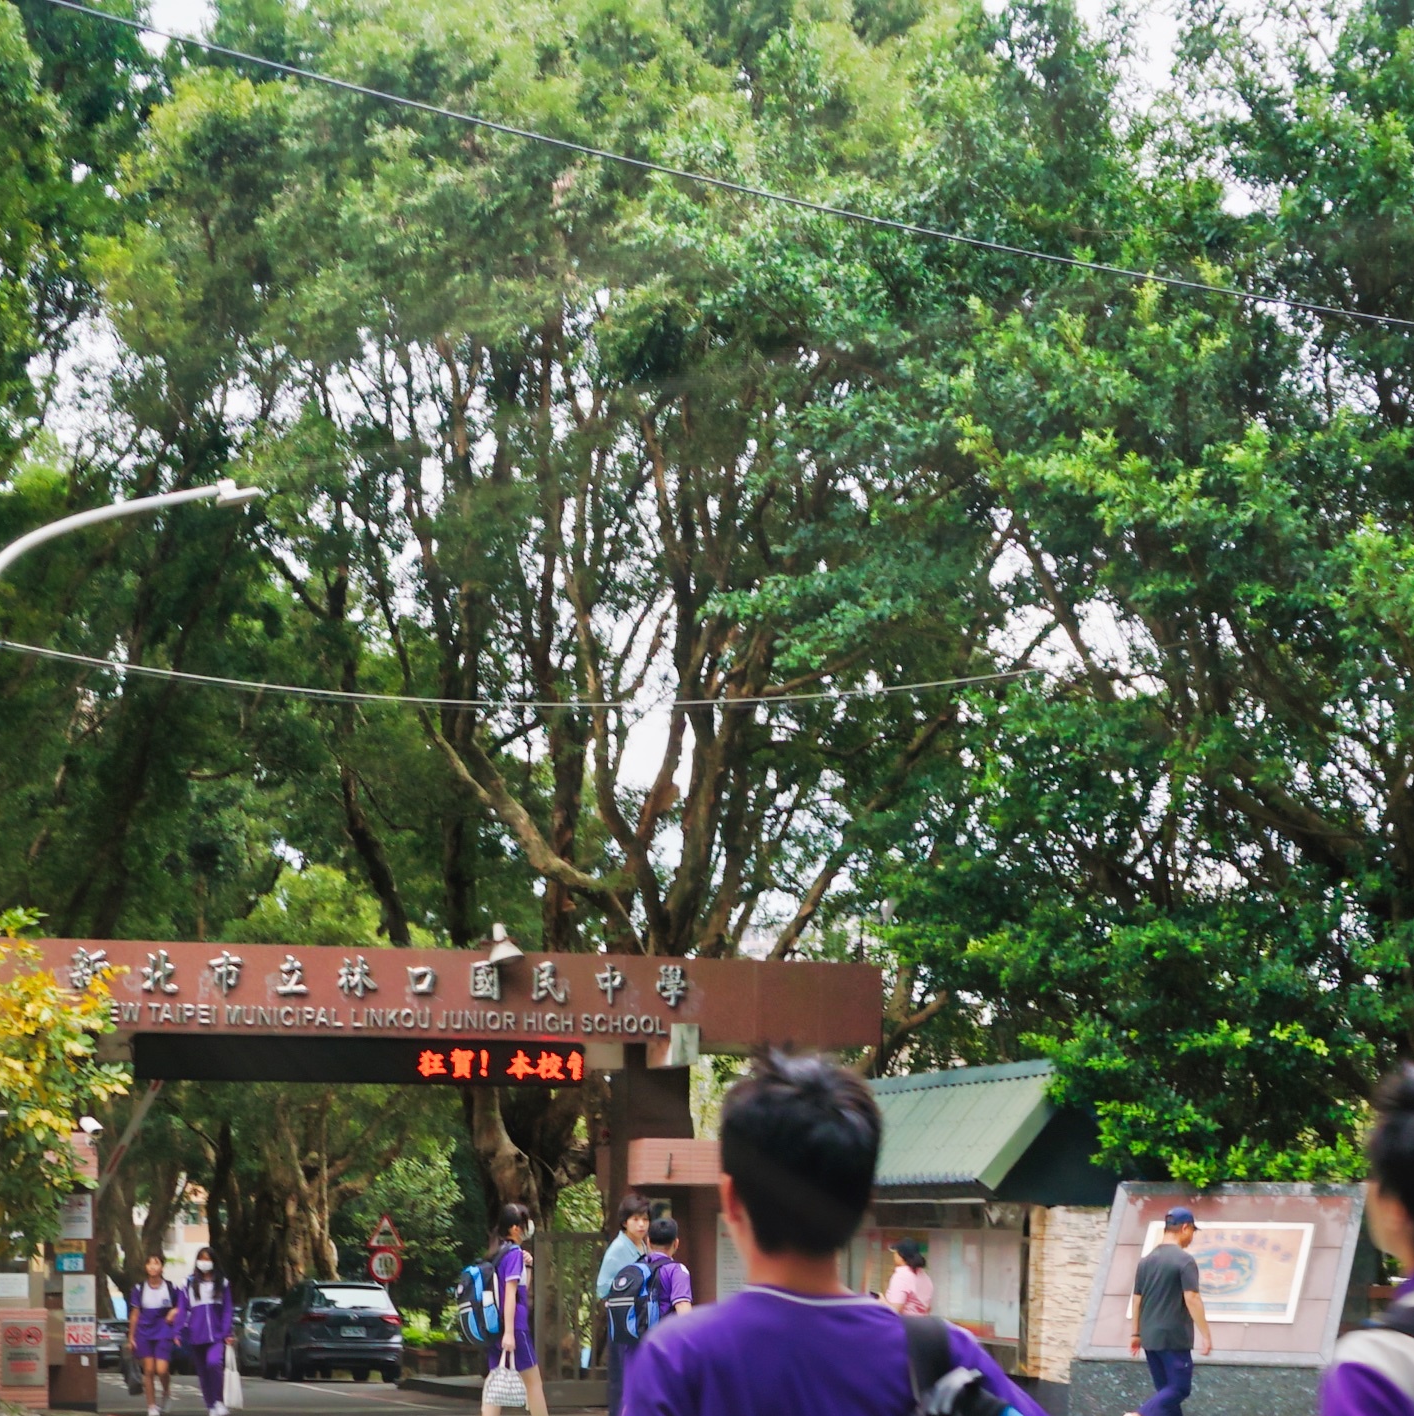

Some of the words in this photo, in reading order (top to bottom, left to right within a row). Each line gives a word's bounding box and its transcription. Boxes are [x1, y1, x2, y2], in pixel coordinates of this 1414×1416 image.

[70, 946, 688, 1007] 新北市立林口國民中學
[109, 1001, 141, 1023] EW
[148, 1002, 217, 1025] TAIPEI
[224, 1004, 344, 1028] MUNICIPAL
[350, 1007, 431, 1029] LINKOU
[437, 1009, 516, 1032] JUNIOR
[523, 1012, 574, 1033] HIGH
[581, 1012, 668, 1036] SCHOOL
[1202, 1231, 1293, 1263] 立林口國民中學
